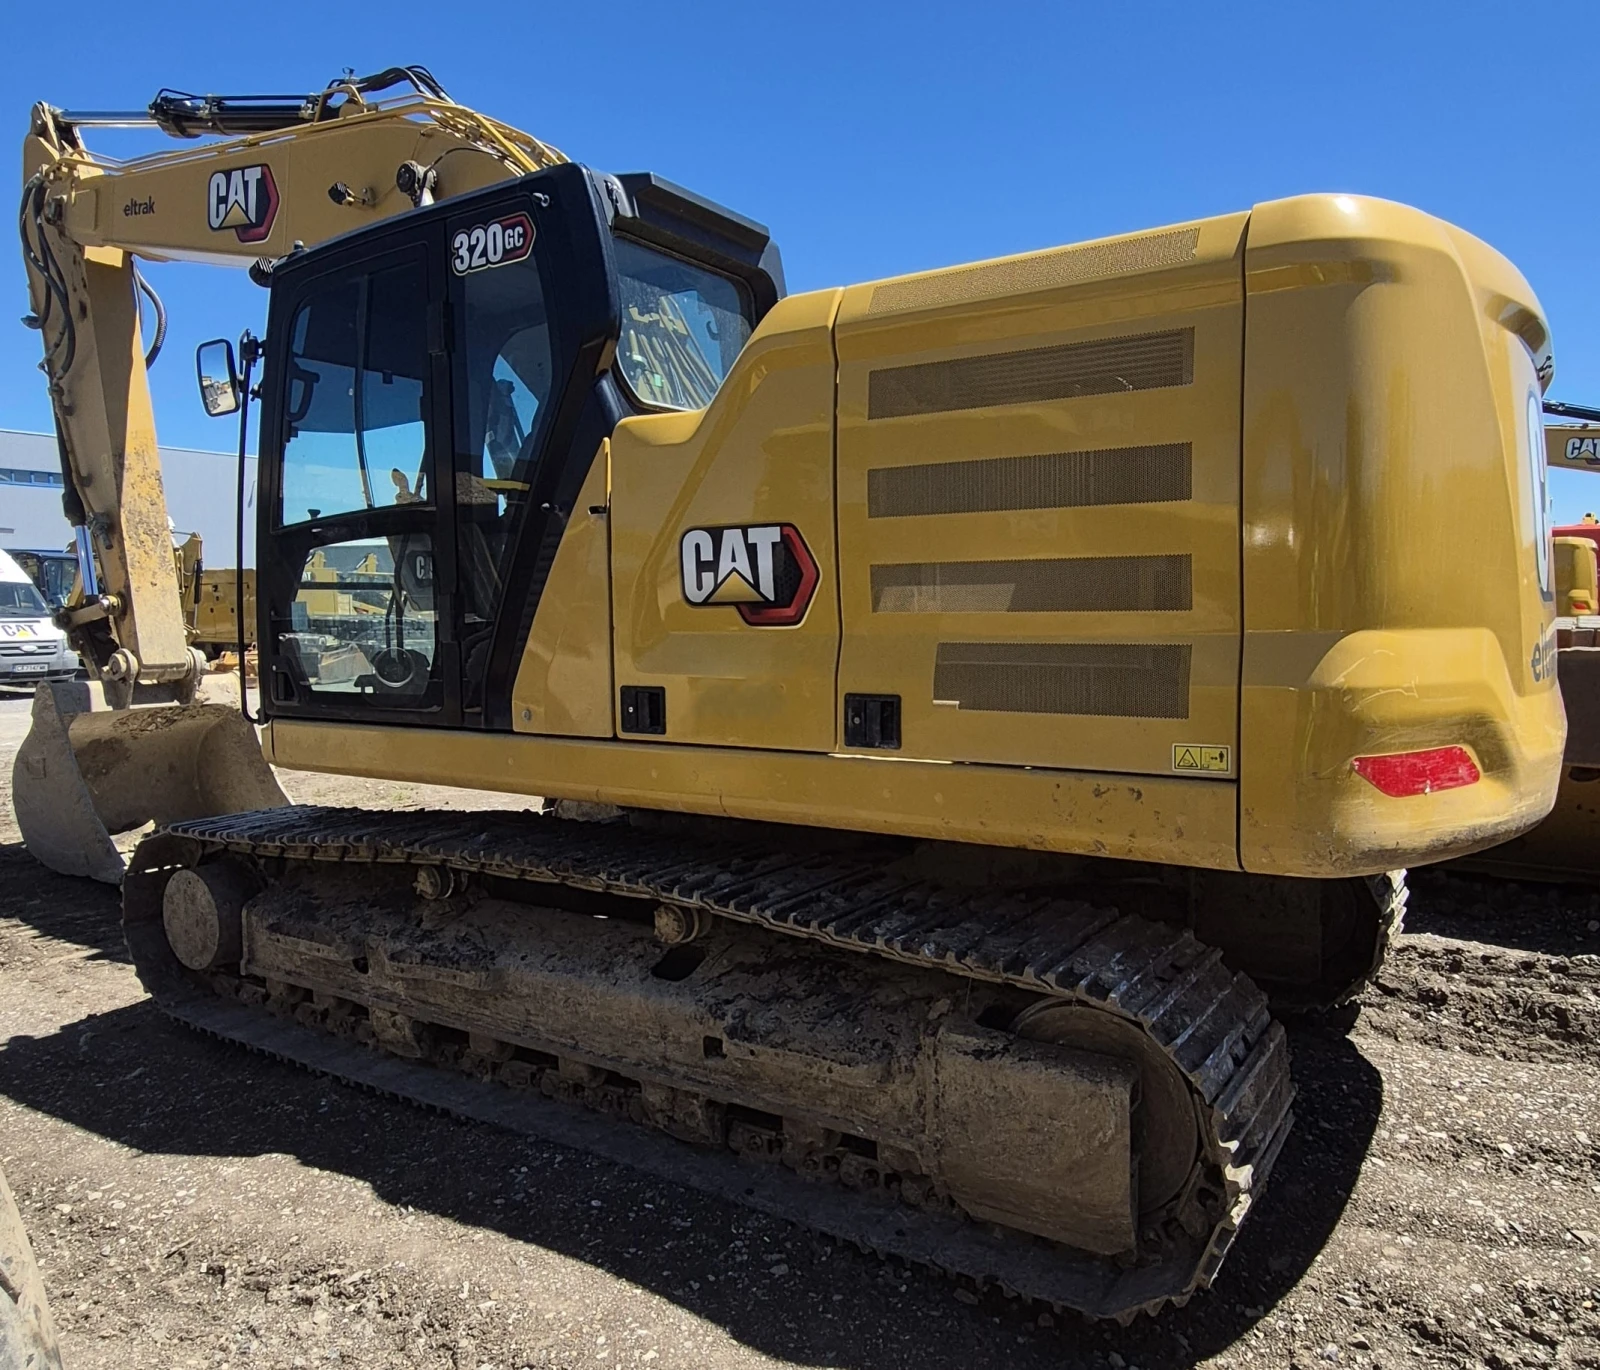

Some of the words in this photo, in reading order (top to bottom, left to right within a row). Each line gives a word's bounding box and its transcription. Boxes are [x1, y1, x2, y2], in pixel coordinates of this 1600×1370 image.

[123, 196, 156, 216] eltrak
[209, 166, 262, 229] CAT
[454, 223, 504, 271] 320
[682, 526, 781, 603] CAT
[1, 624, 38, 637] CAT
